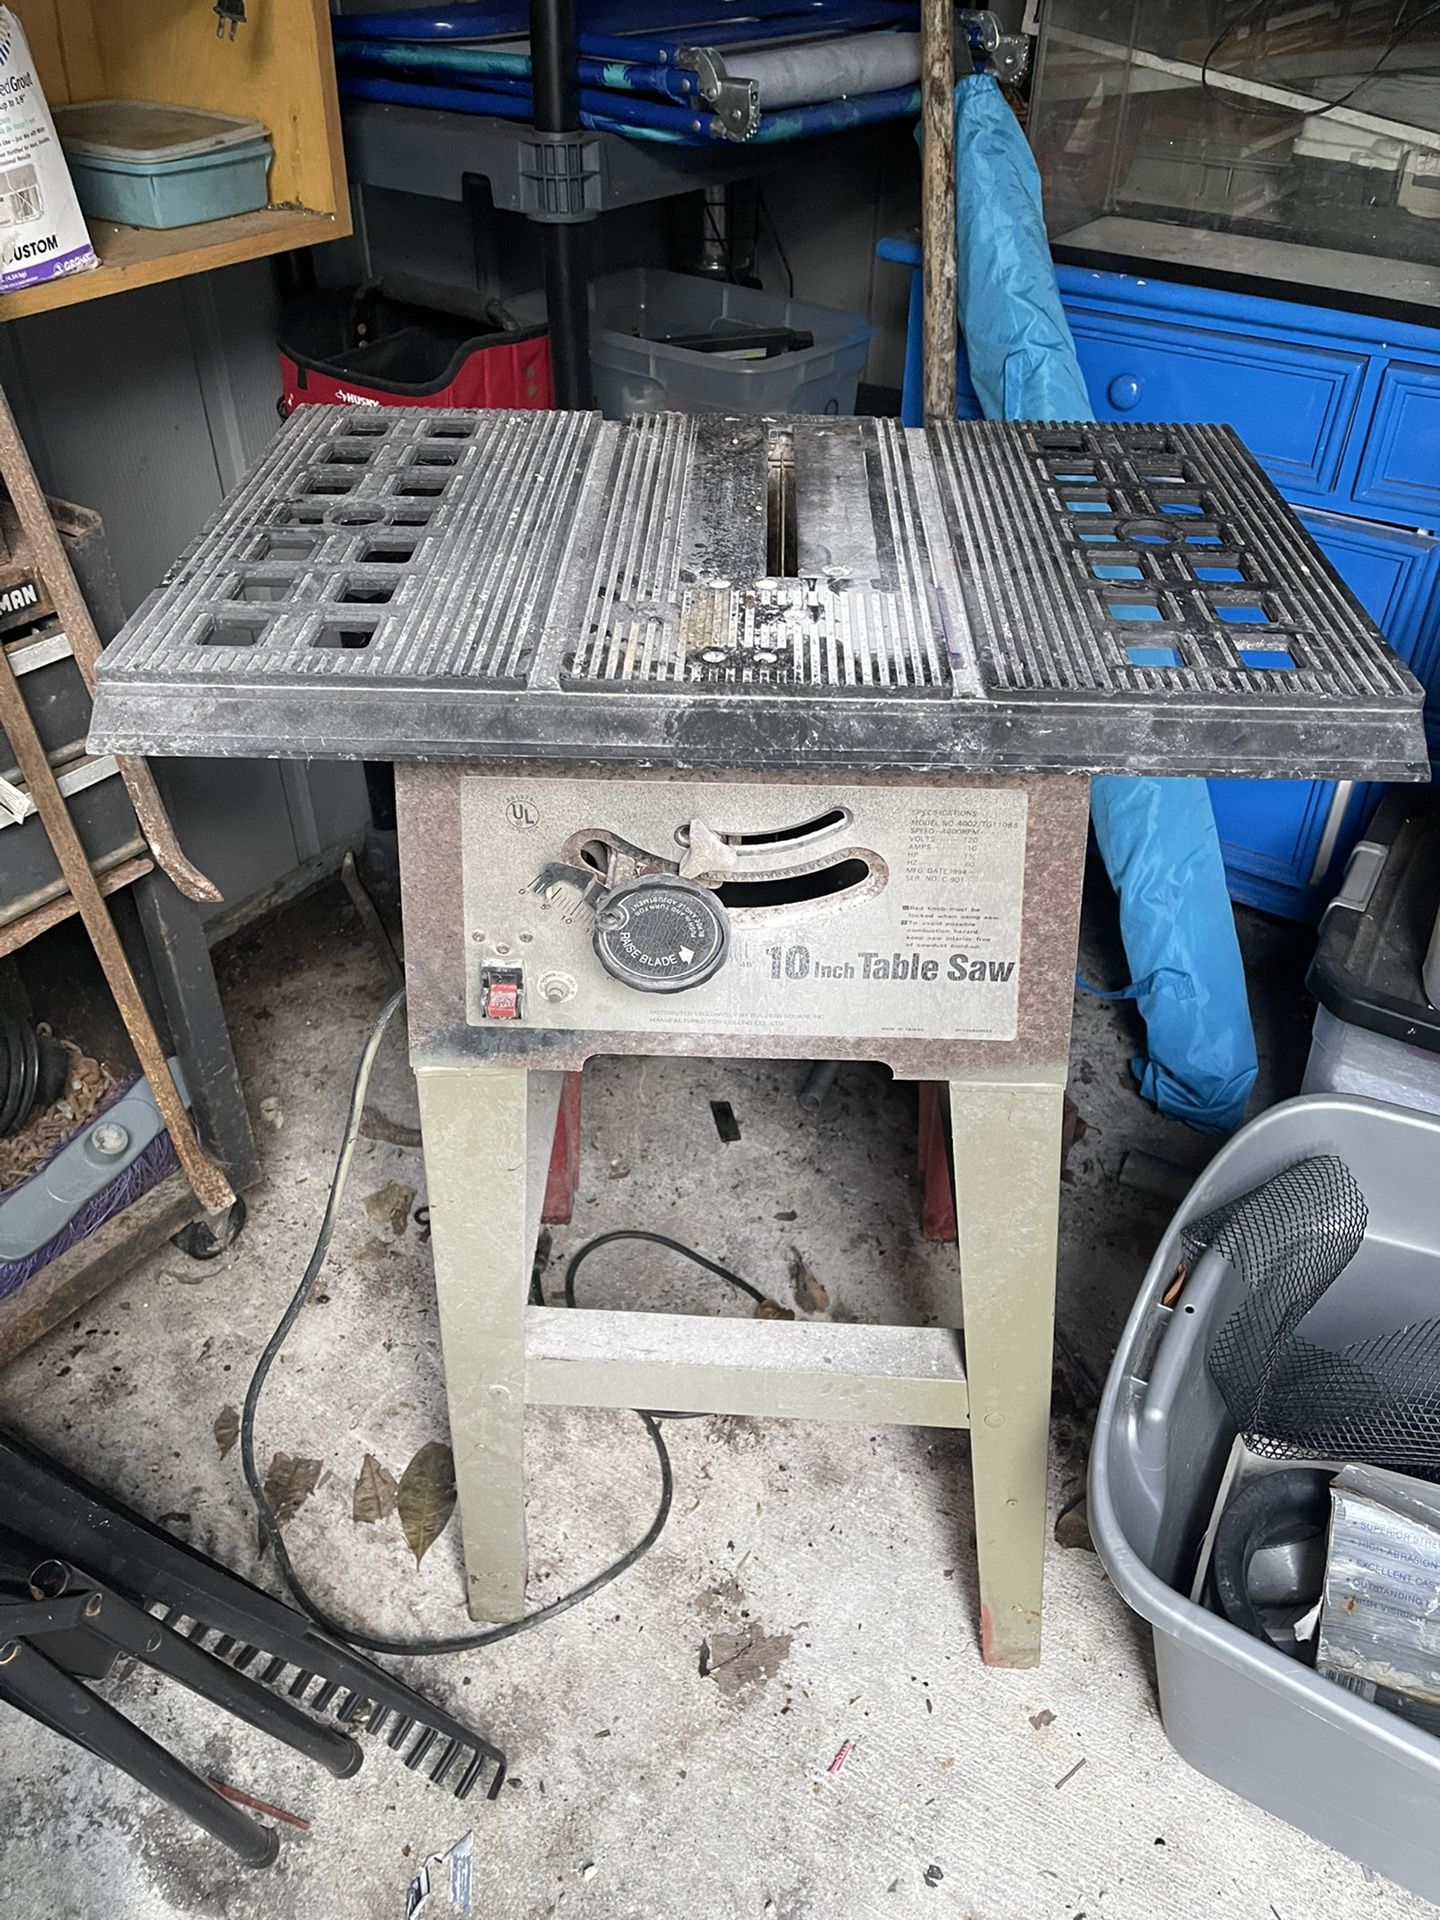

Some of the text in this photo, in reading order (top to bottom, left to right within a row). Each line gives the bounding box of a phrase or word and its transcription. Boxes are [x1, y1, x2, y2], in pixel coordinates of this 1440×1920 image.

[345, 392, 379, 407] HUSKY
[511, 803, 535, 825] UL
[630, 896, 678, 912] ADJUSTMENT
[620, 932, 678, 967] RAISE BLADE
[766, 945, 1016, 982] 10 Inch Table Saw
[1360, 1521, 1411, 1541] SUPERIOR
[1385, 1549, 1438, 1569] ABRASION
[1356, 1559, 1412, 1583] EXCELLENT
[1352, 1577, 1424, 1607] OUTSTANDING
